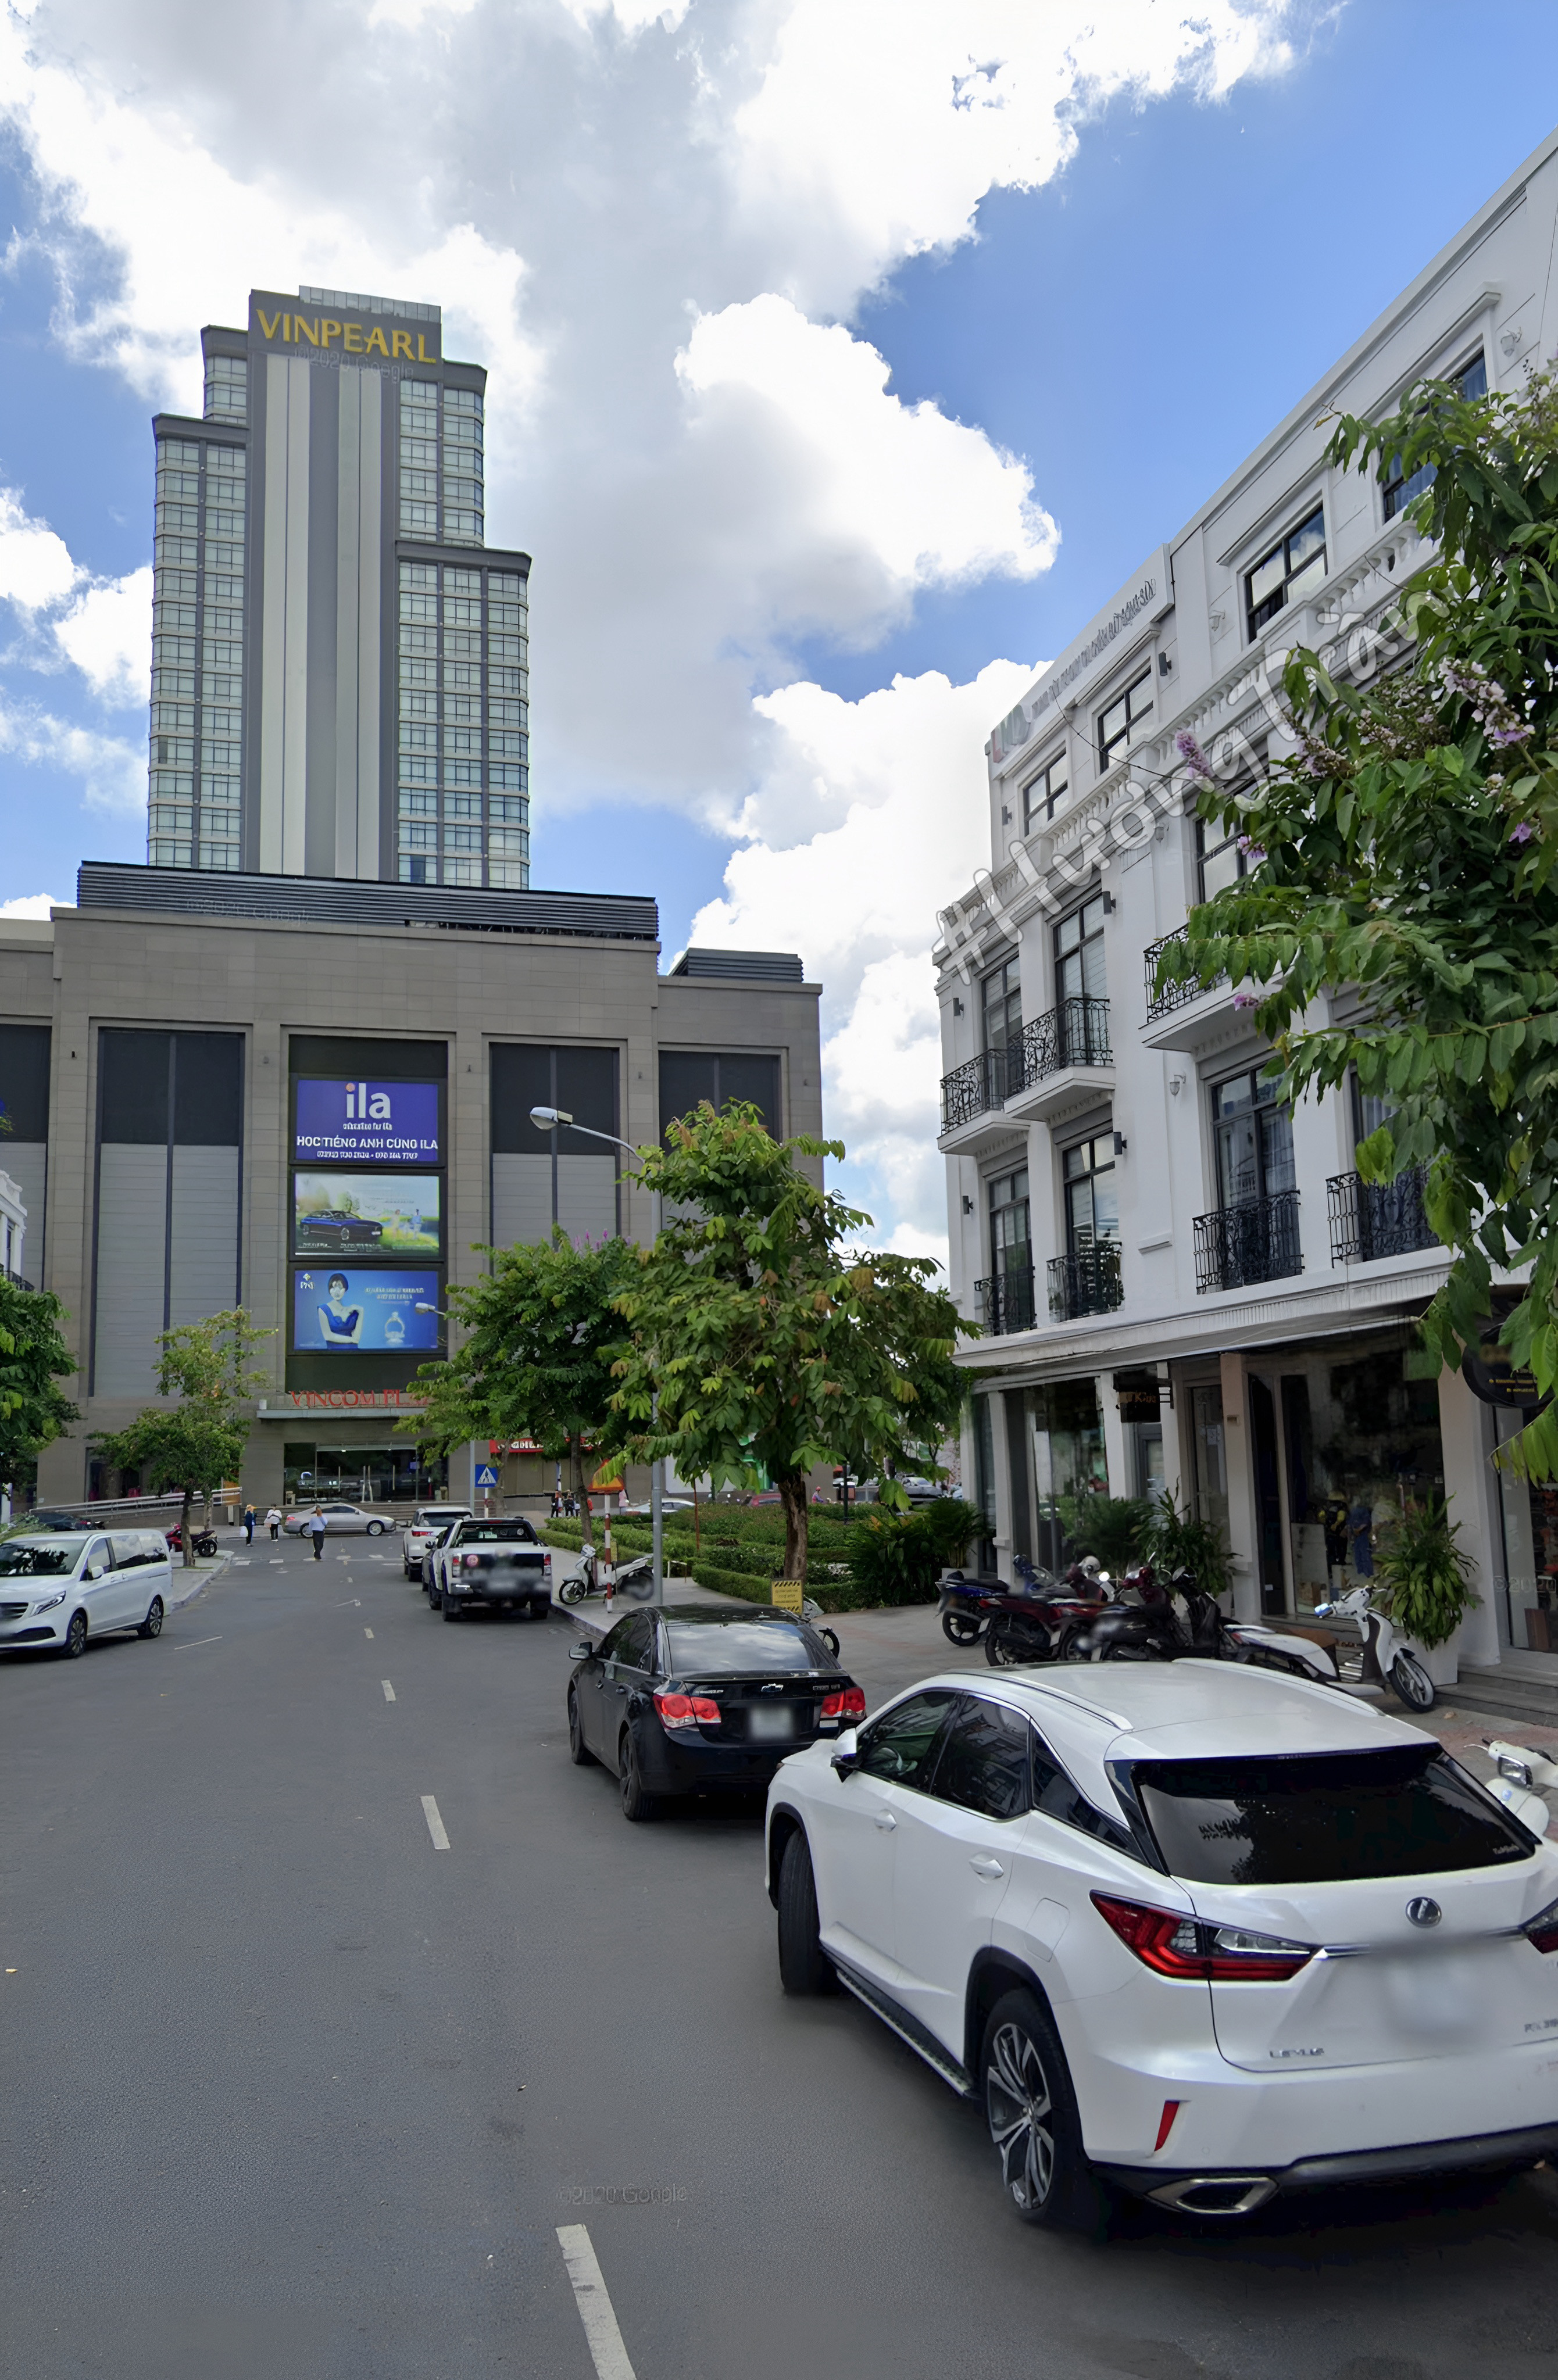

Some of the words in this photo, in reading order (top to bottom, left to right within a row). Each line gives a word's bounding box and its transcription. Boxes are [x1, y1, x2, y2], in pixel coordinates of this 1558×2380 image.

[256, 309, 437, 364] VINPEARL
[346, 1082, 391, 1119] ila
[359, 1138, 384, 1148] ANH
[420, 1139, 438, 1150] ILA
[290, 1390, 375, 1407] VINCOM
